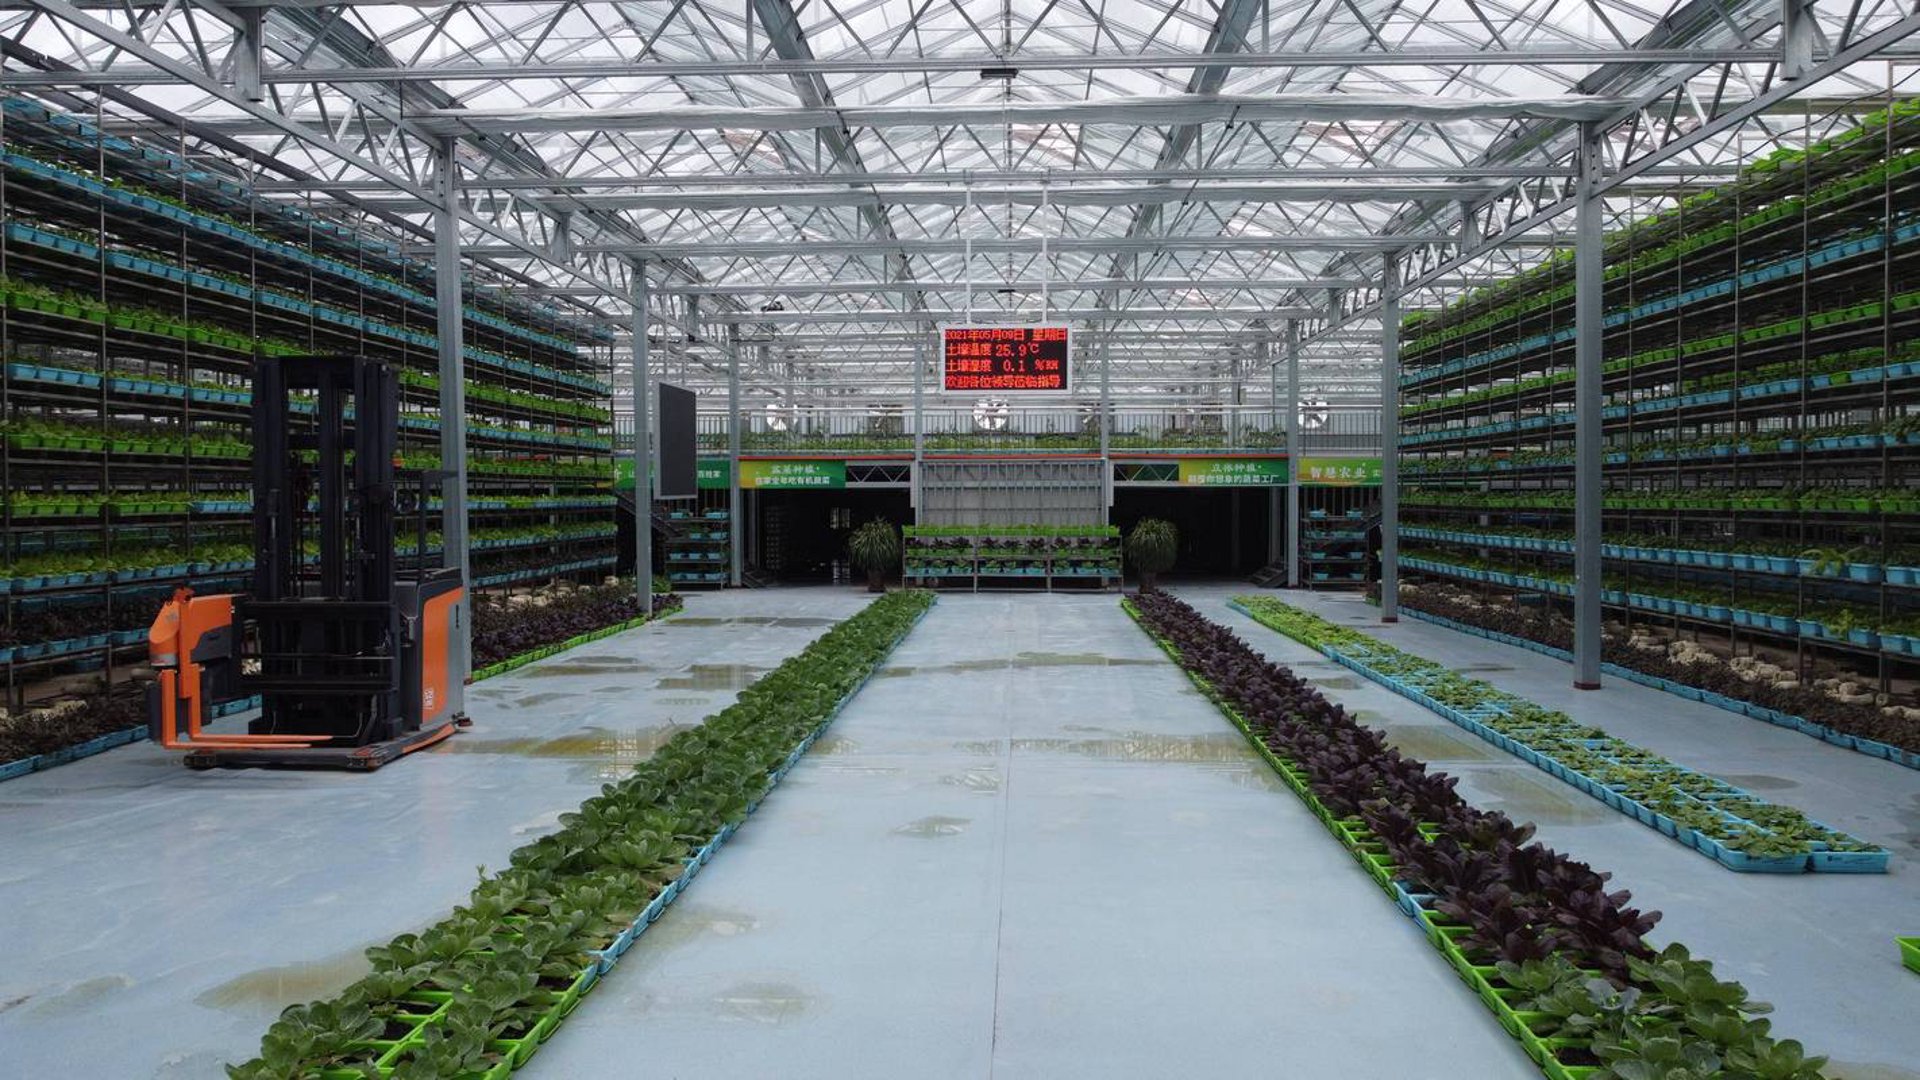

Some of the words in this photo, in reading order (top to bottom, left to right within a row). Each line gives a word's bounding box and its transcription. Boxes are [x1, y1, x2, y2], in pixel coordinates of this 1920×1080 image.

[946, 329, 1025, 341] 2021年05月09日
[1032, 329, 1066, 341] 星期日
[946, 343, 991, 356] 土壤温度
[946, 359, 991, 372] 土壤湿度
